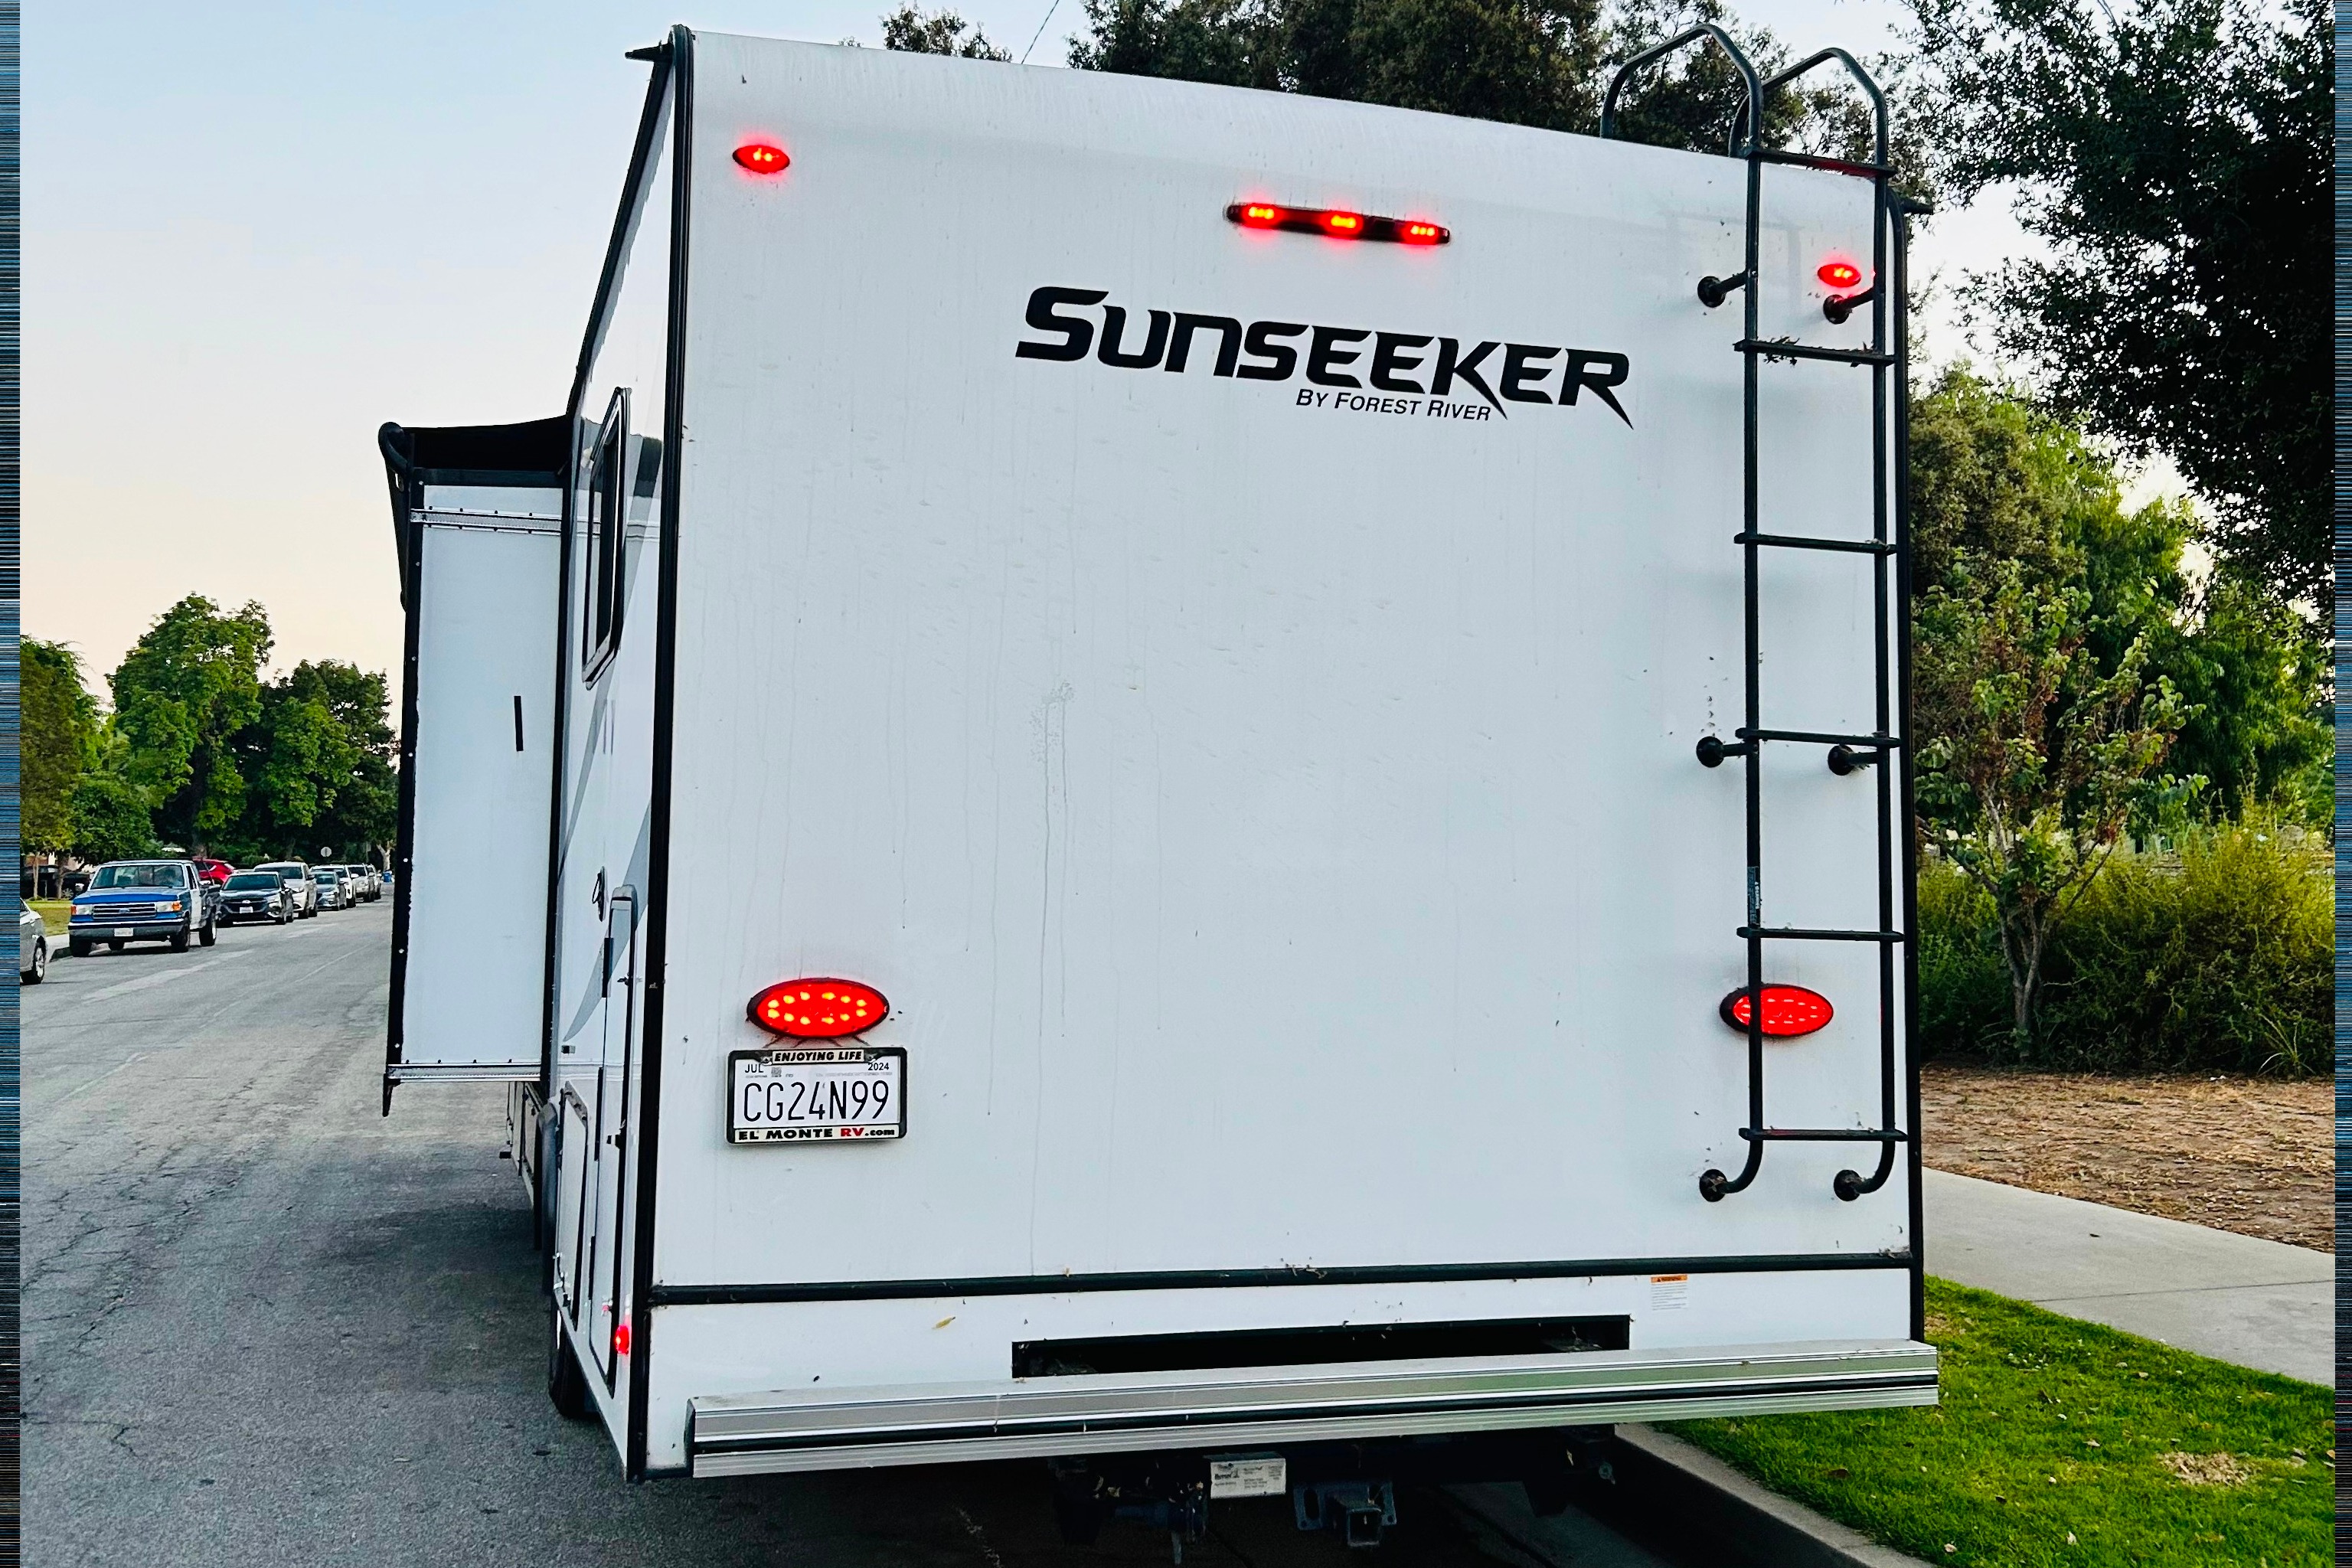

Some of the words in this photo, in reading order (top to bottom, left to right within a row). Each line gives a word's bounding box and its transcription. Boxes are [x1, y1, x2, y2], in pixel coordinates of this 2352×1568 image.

[1015, 286, 1634, 430] SUNSEEKER
[1296, 388, 1329, 408] BY
[1334, 392, 1422, 416] FOREST
[1426, 400, 1491, 421] RIVER
[744, 1063, 764, 1073] JUL
[867, 1062, 890, 1071] 2024
[774, 1051, 835, 1062] ENJOYING
[838, 1050, 862, 1061] LIFE
[743, 1080, 890, 1122] CG24N99
[739, 1131, 759, 1141] EL
[766, 1128, 833, 1140] MONTE
[841, 1127, 895, 1138] RV.com
